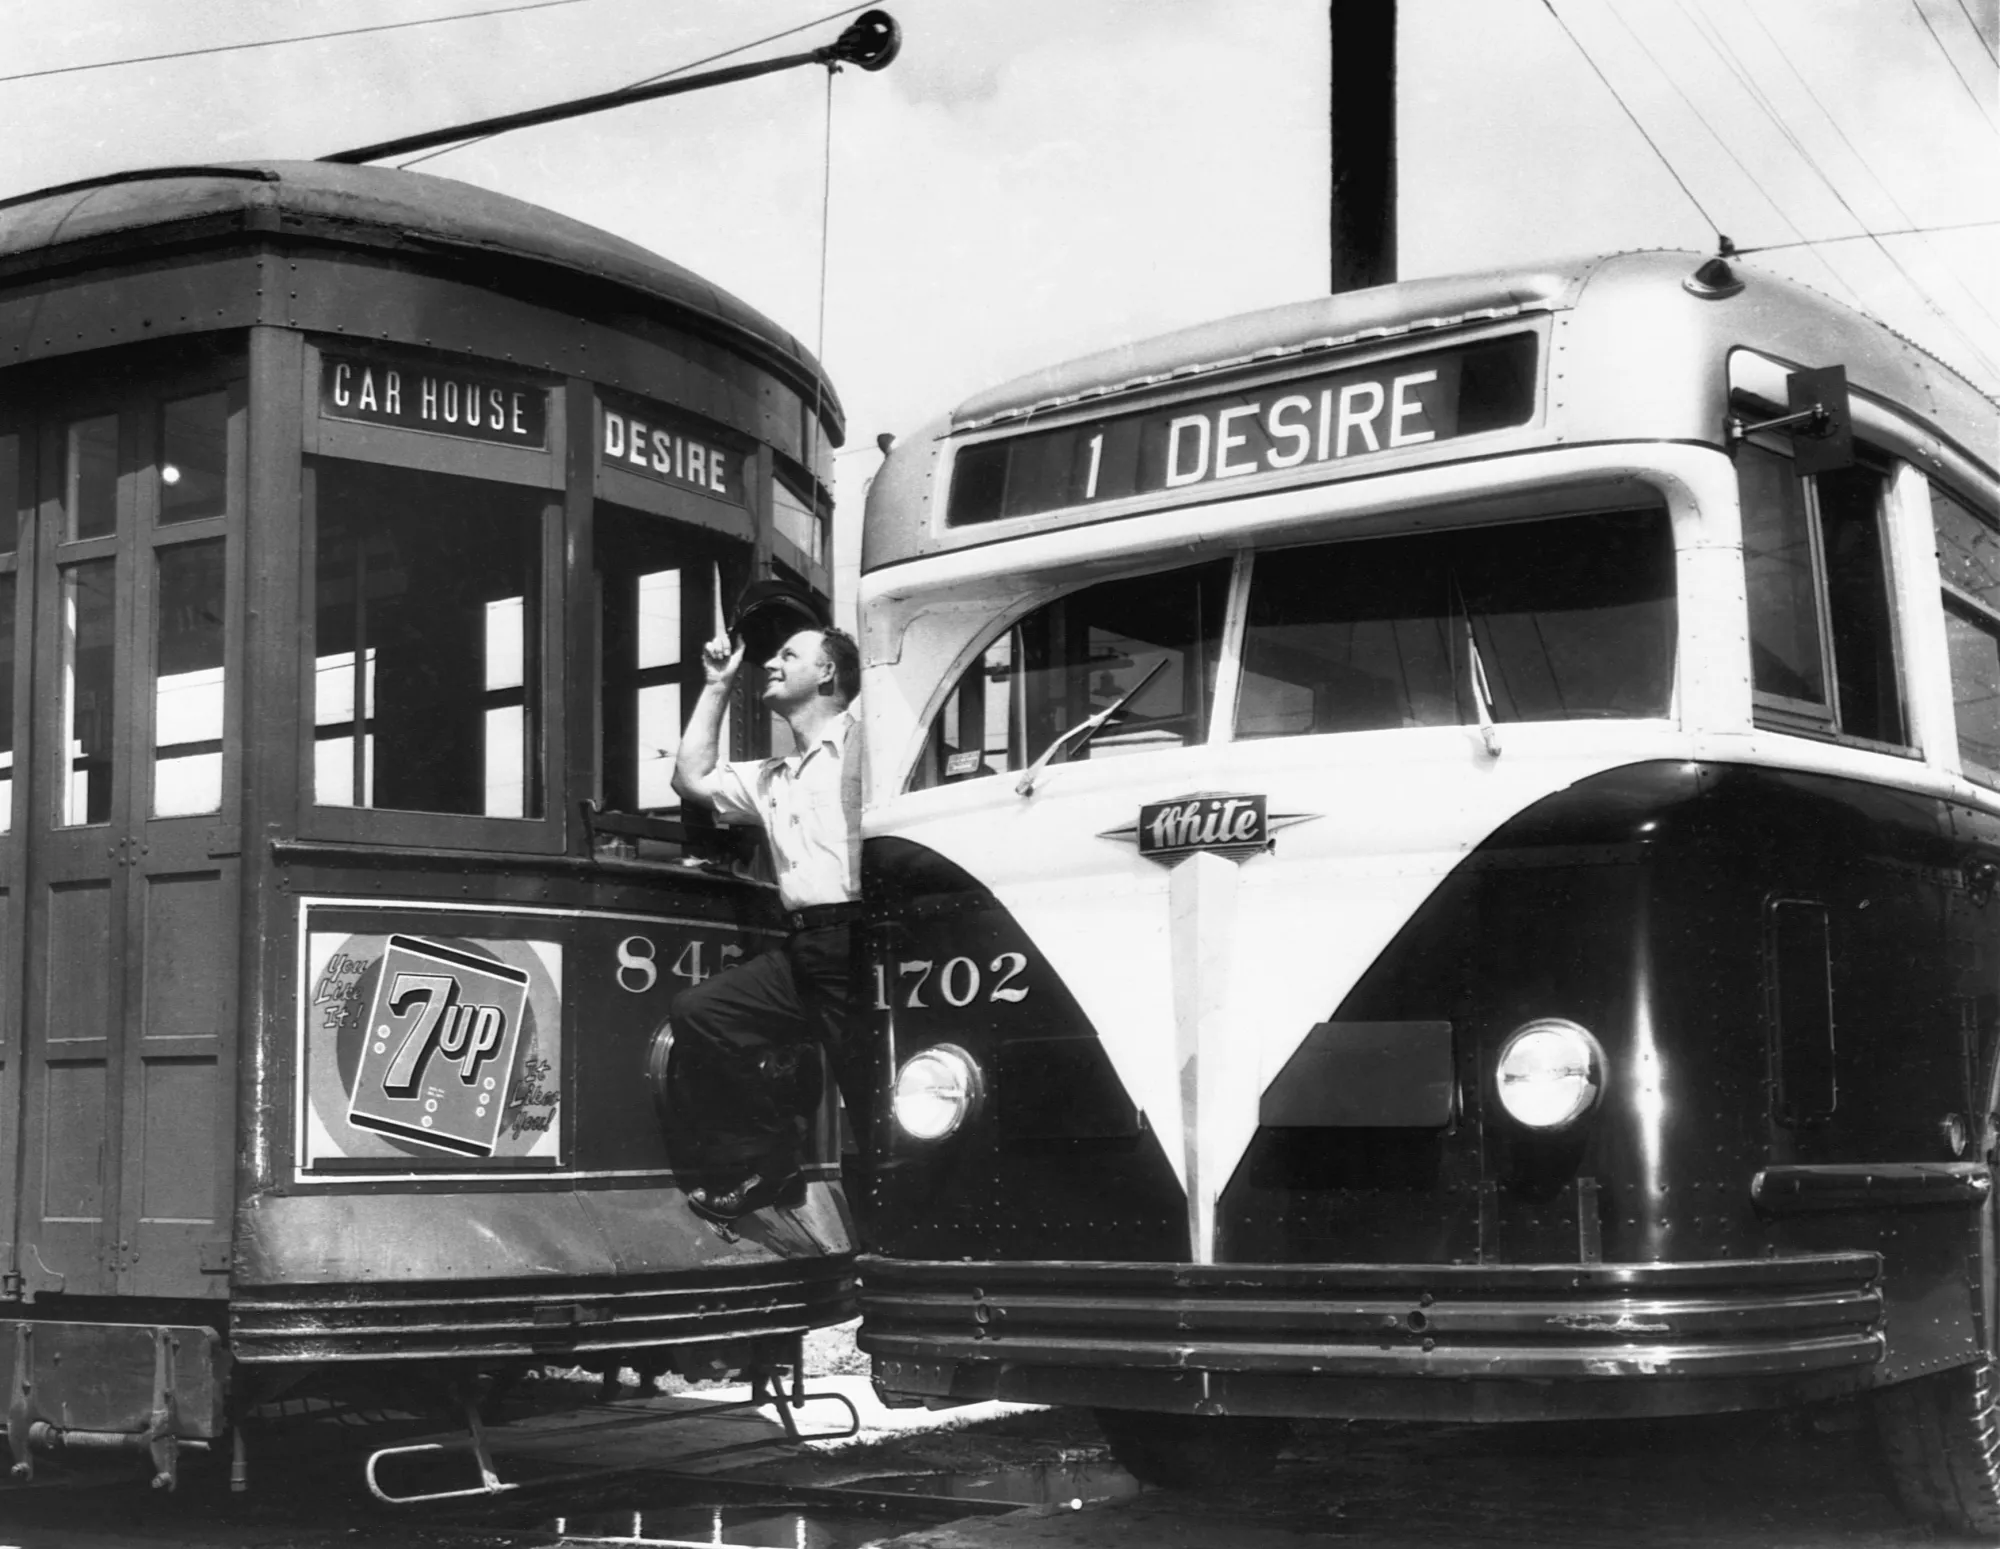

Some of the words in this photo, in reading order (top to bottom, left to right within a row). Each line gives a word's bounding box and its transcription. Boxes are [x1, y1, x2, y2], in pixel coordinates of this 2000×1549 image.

[334, 363, 401, 414] CAR
[421, 376, 528, 434] HOUSE
[603, 412, 727, 494] DESIRE
[1086, 433, 1103, 499] 1
[1166, 370, 1437, 488] DESIRE
[1145, 799, 1259, 848] White
[312, 978, 363, 1006] Like
[327, 953, 369, 983] You
[873, 952, 1030, 1010] 1702
[524, 1058, 552, 1083] It
